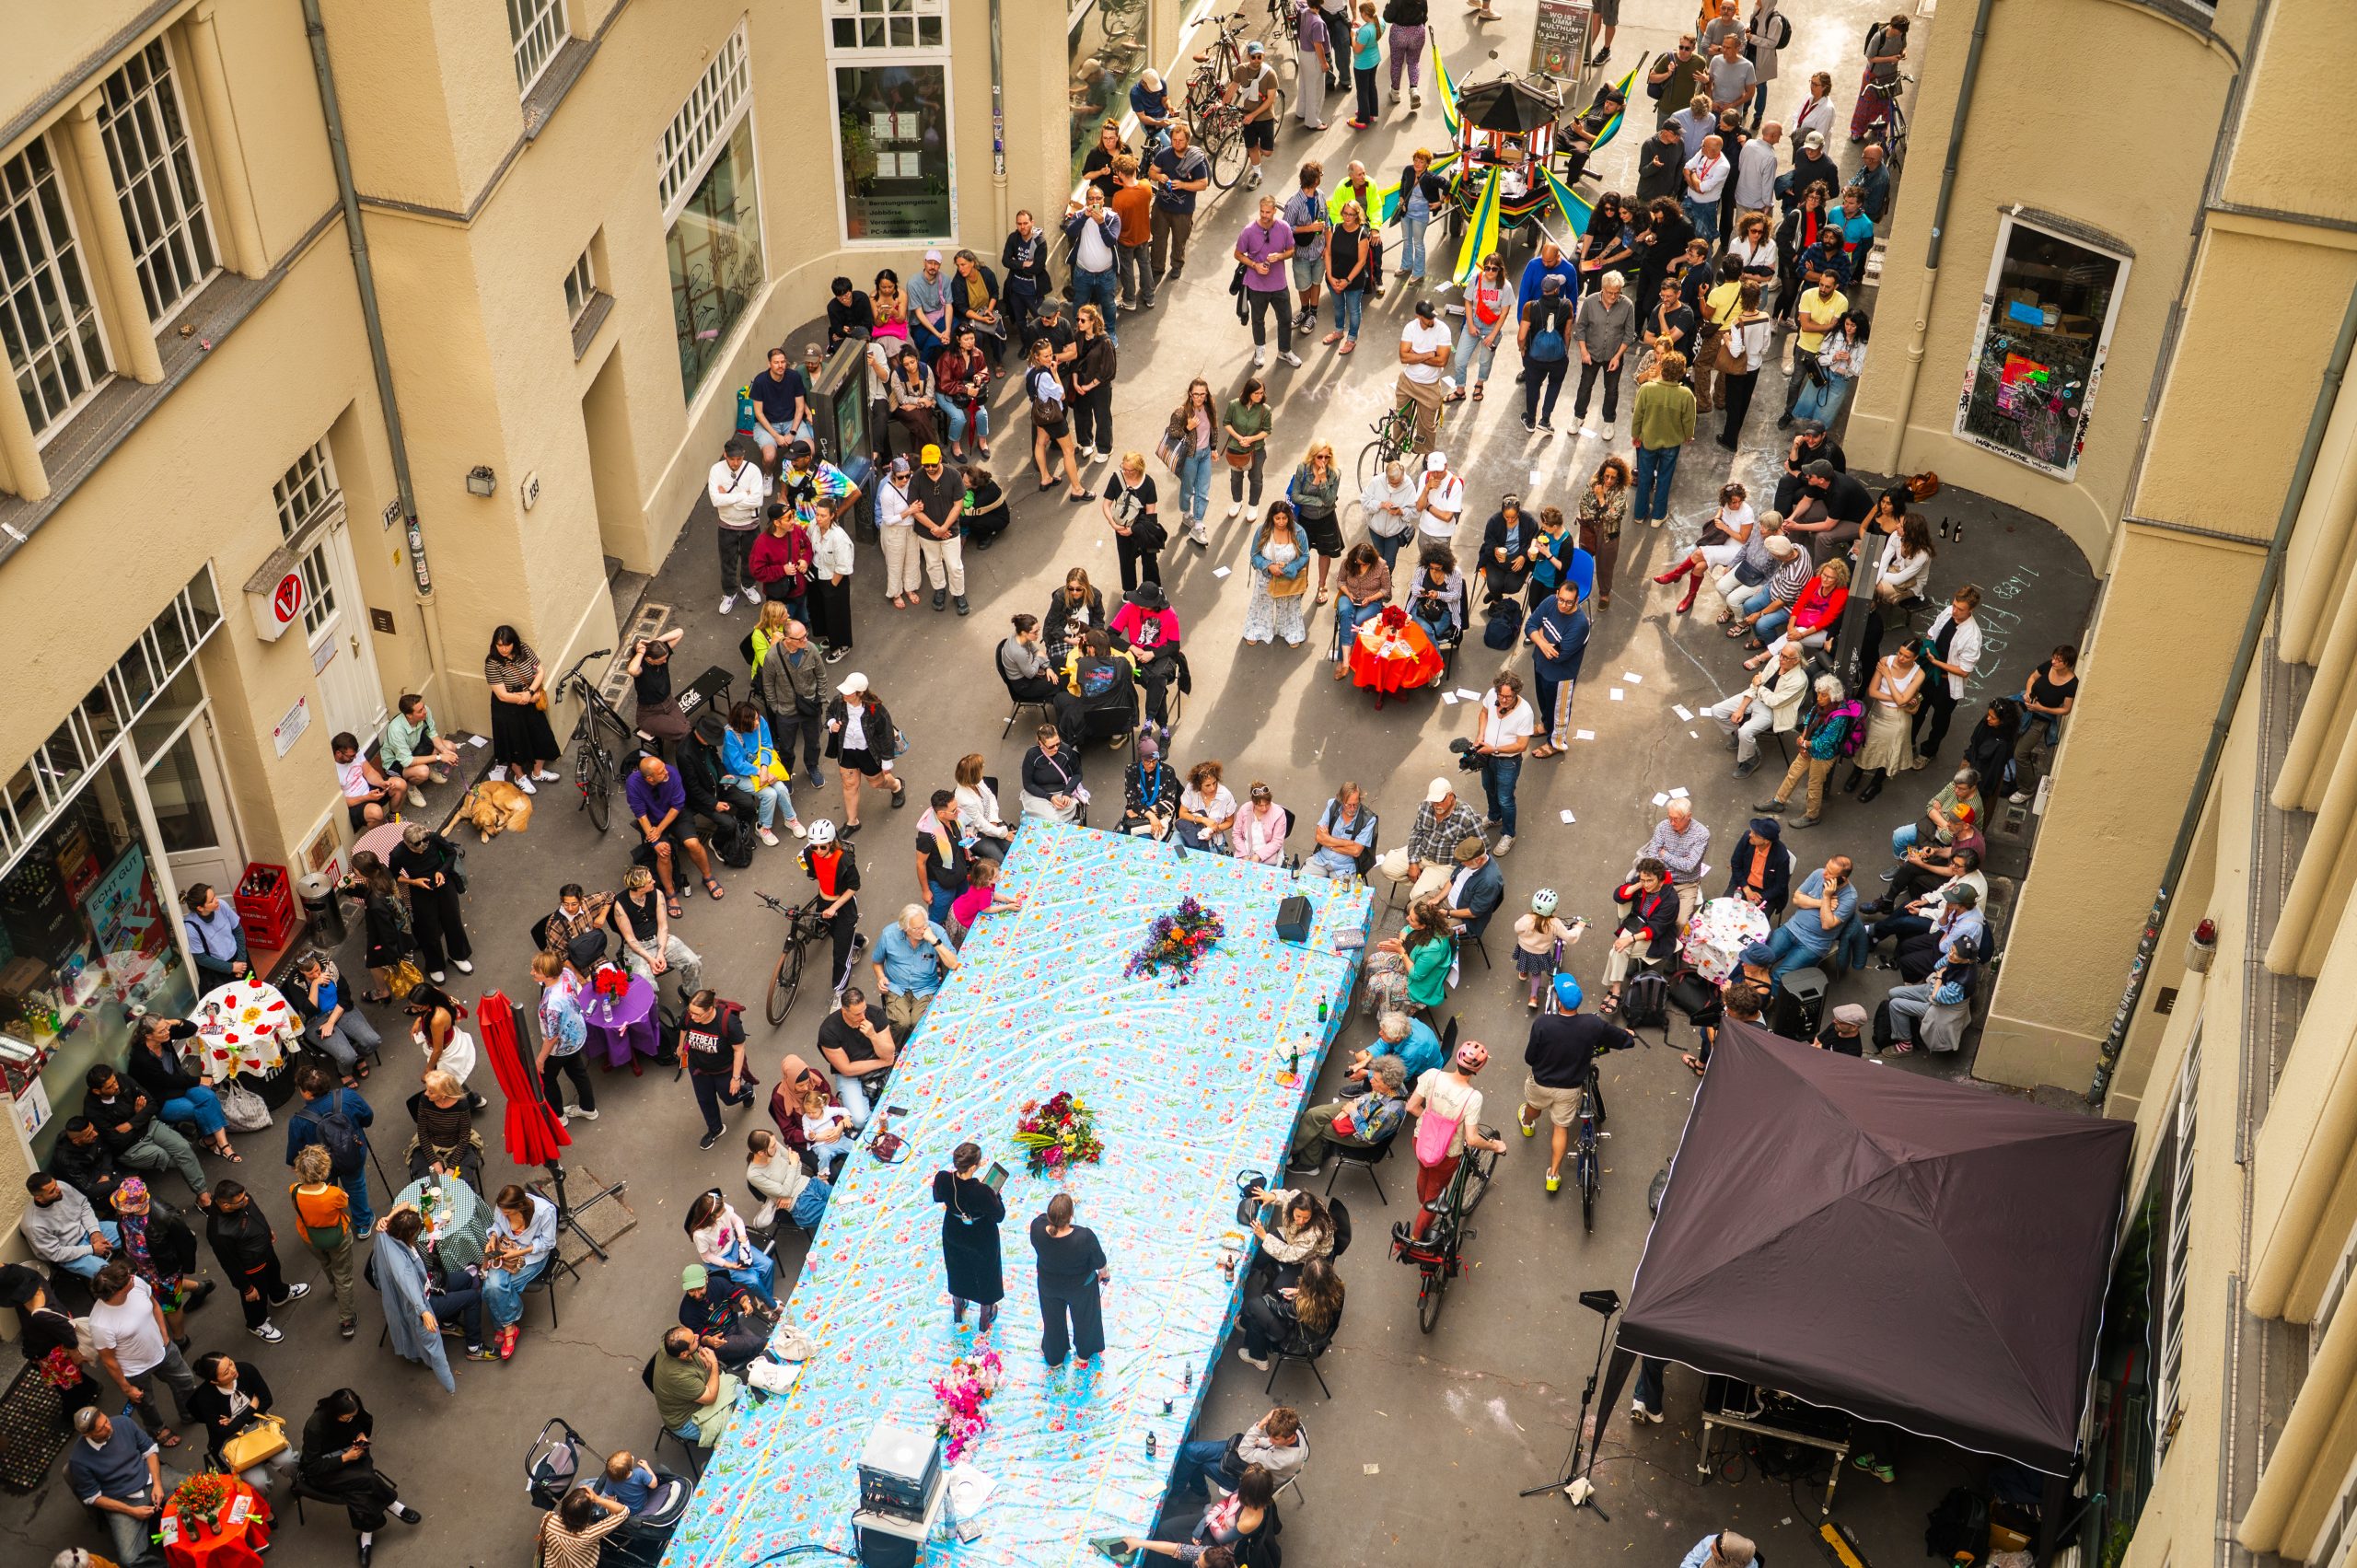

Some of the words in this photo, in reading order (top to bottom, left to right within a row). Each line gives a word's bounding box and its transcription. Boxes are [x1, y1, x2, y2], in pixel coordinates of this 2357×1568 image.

[1540, 22, 1584, 34] KULTHUM?
[1552, 18, 1573, 27] UMM
[868, 199, 938, 207] Beratungsangebote
[529, 479, 540, 501] 133
[385, 500, 401, 528] 133
[92, 879, 118, 912] ECHT
[118, 854, 139, 881] GUT
[689, 1031, 719, 1046] OFFBEAT
